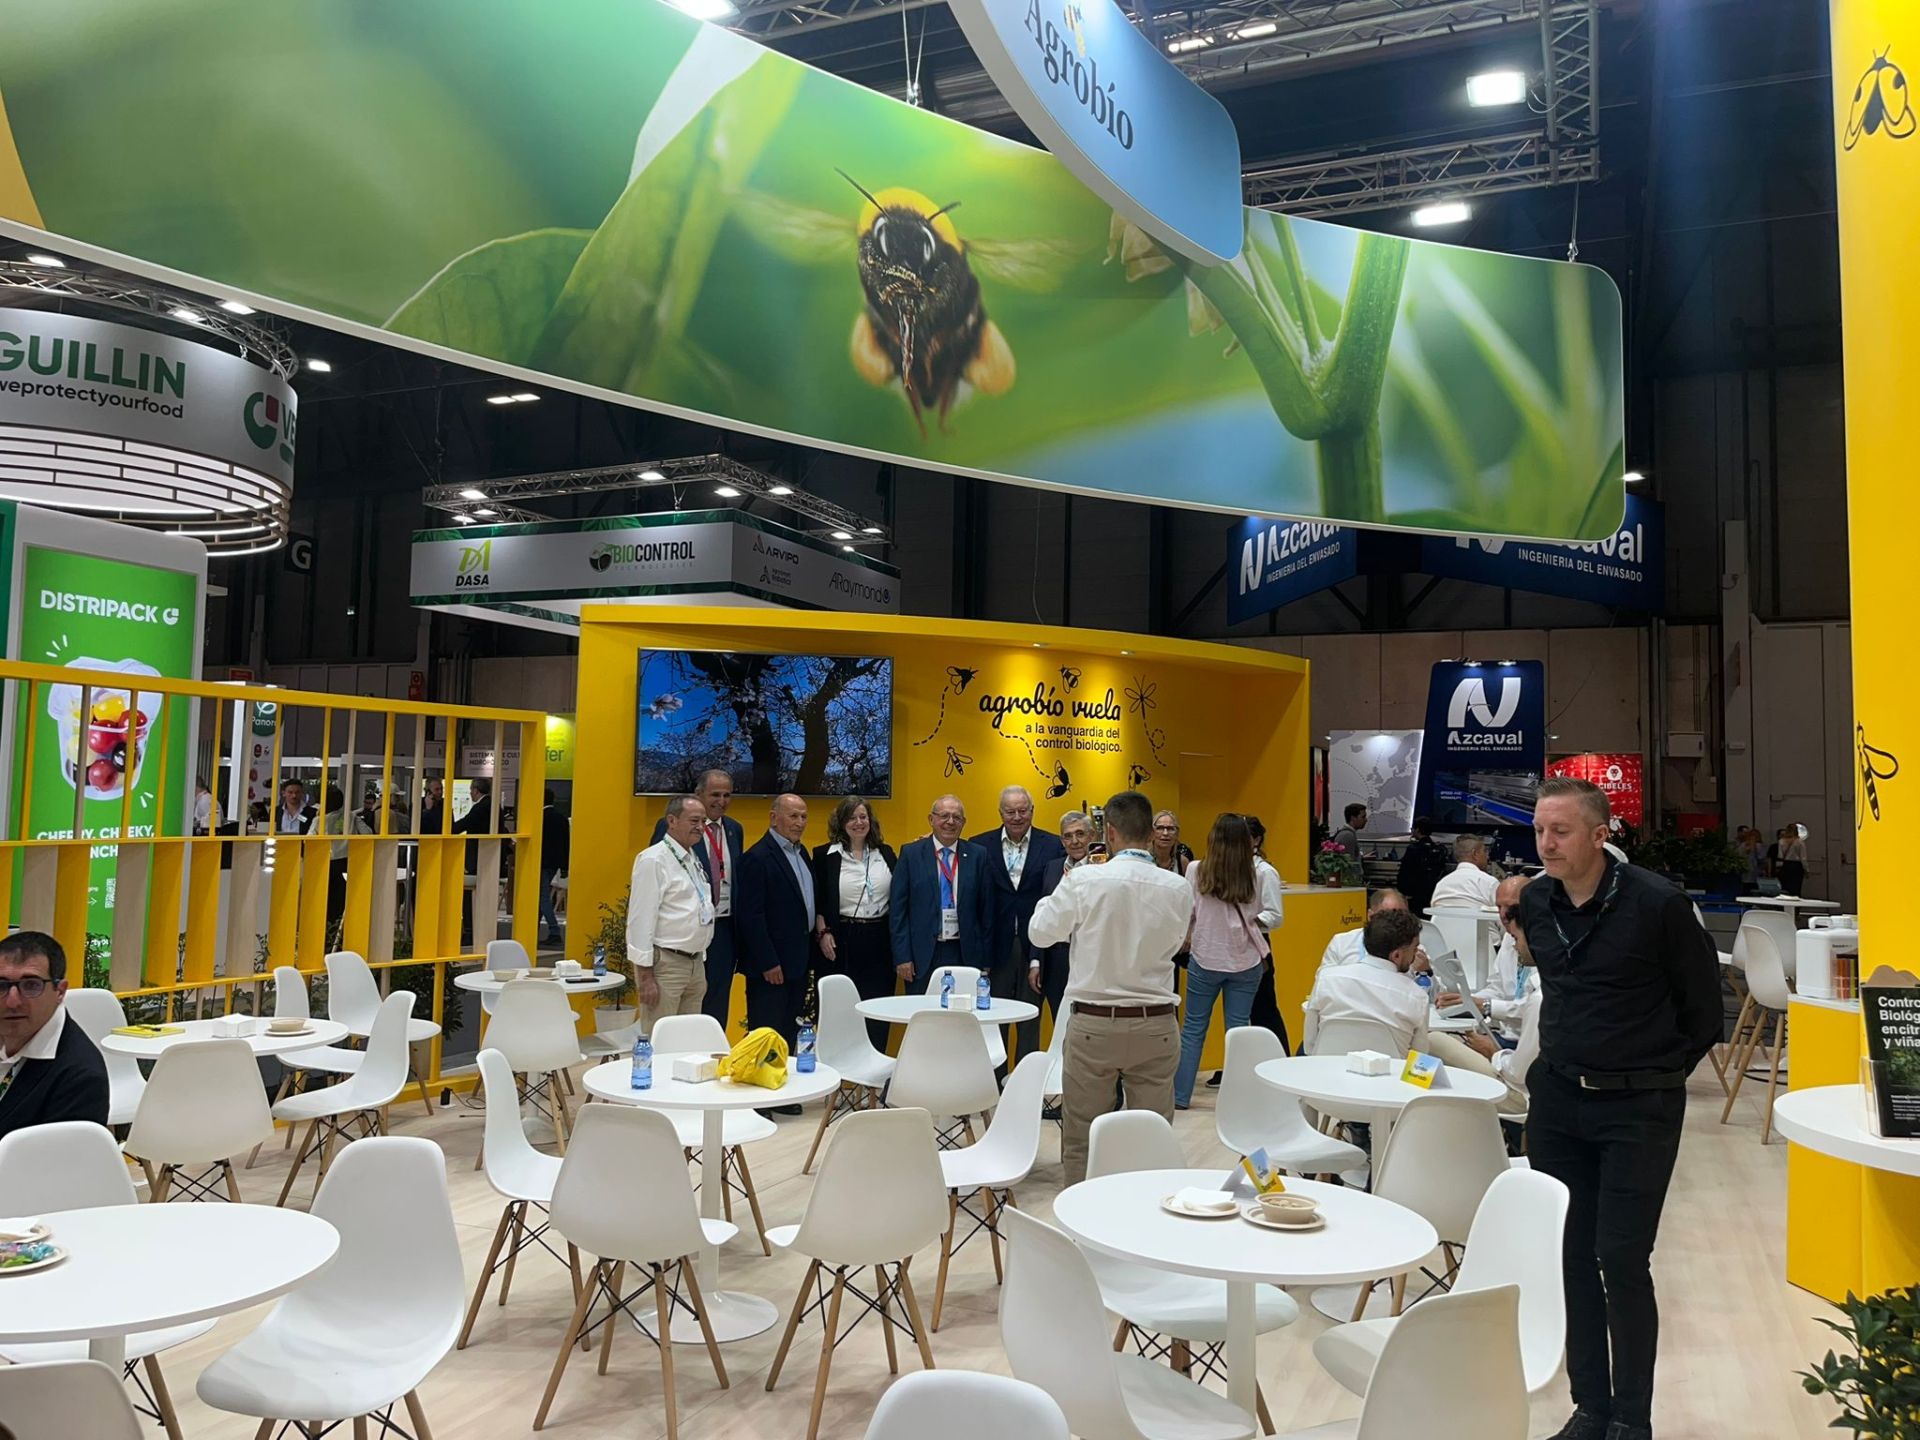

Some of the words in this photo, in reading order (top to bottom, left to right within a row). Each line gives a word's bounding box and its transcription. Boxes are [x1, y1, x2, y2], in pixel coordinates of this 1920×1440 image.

[1024, 0, 1133, 150] Agrobío
[0, 331, 186, 399] GUILLIN
[291, 540, 312, 569] G
[613, 541, 695, 564] BIOCONTROL
[1297, 559, 1308, 571] DEL
[1309, 542, 1340, 565] ENVASADO
[1518, 548, 1573, 569] INGENIERIA
[1577, 561, 1594, 573] DEL
[1597, 563, 1642, 582] ENVASADO
[456, 574, 489, 587] DASA
[40, 589, 158, 623] DISTRIPACK
[979, 682, 1064, 729] agrobío
[1072, 688, 1121, 721] vuela
[1025, 724, 1032, 733] a
[1035, 722, 1045, 733] la
[1047, 725, 1104, 739] vanguardia
[1106, 728, 1120, 739] del
[1447, 730, 1522, 745] Azcaval
[545, 746, 565, 762] fer
[1036, 737, 1073, 750] control
[1075, 739, 1122, 754] biológico.
[1878, 996, 1920, 1008] Contro
[1879, 1009, 1920, 1024] Biológ
[1881, 1025, 1898, 1034] en
[1899, 1024, 1920, 1035] cítr
[1883, 1037, 1891, 1049] y
[1894, 1035, 1920, 1047] viña
